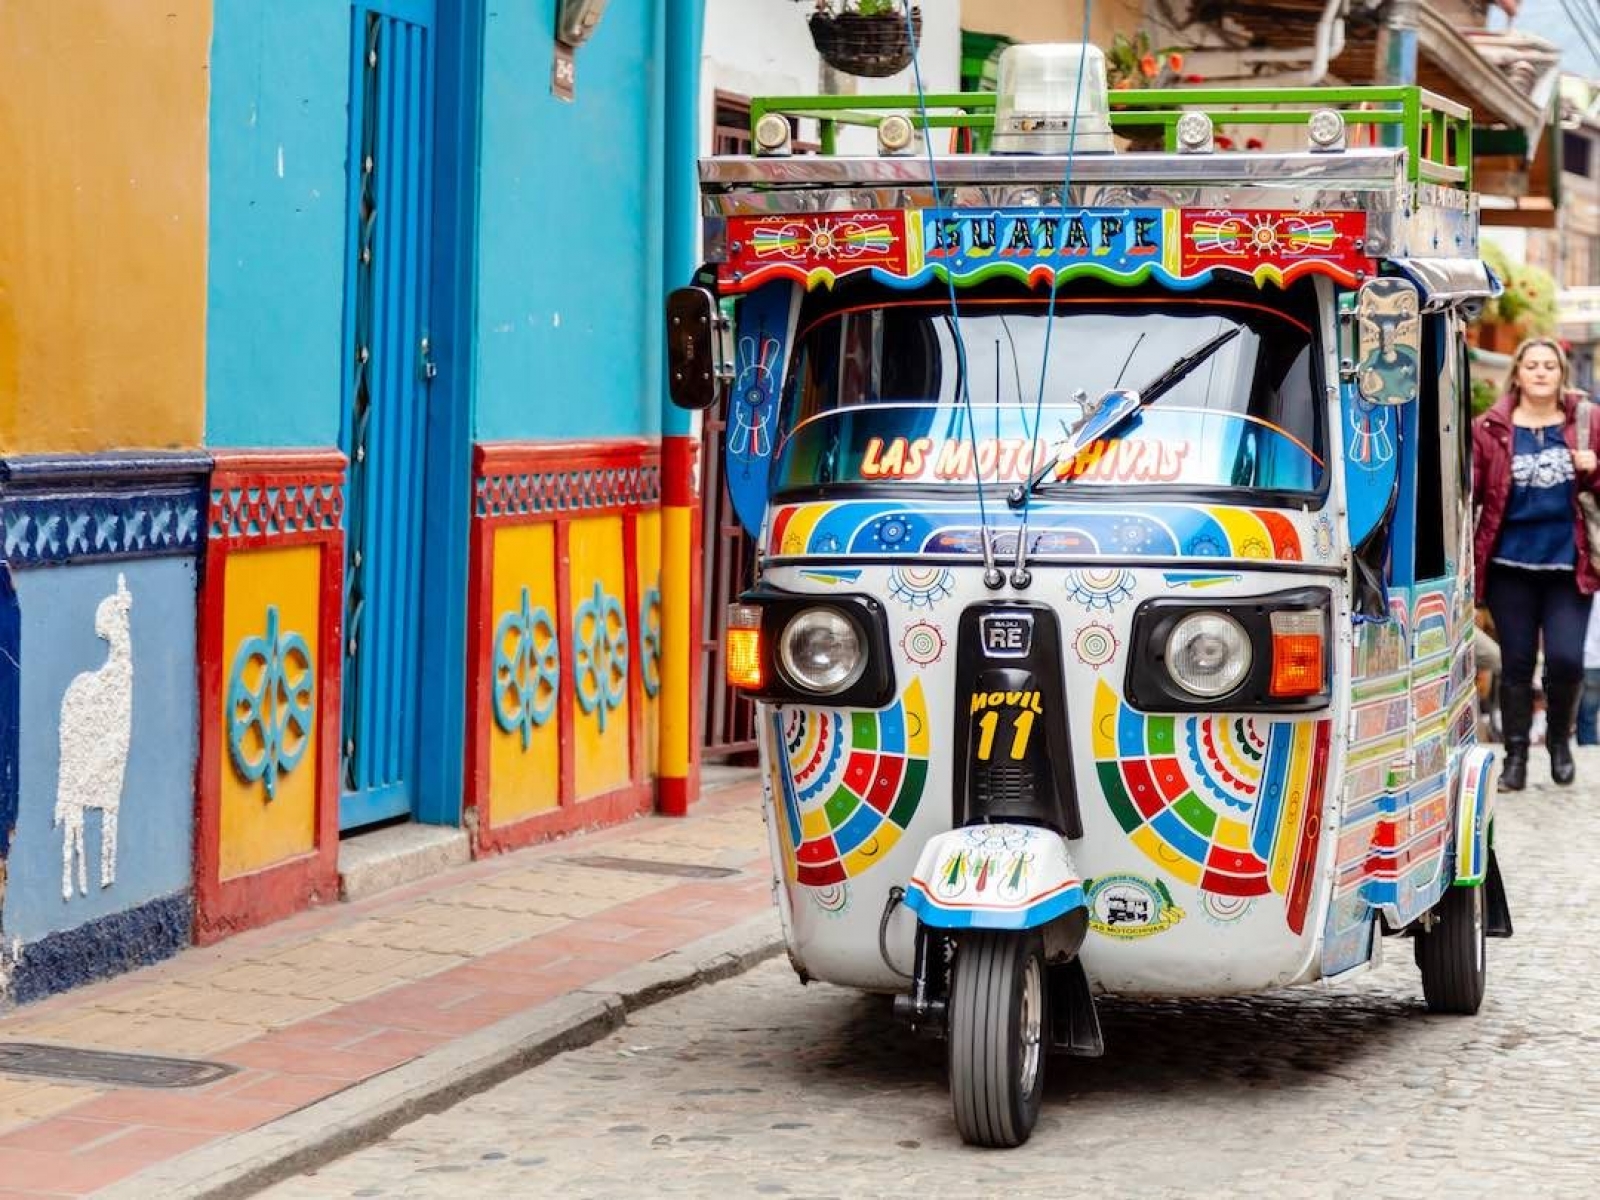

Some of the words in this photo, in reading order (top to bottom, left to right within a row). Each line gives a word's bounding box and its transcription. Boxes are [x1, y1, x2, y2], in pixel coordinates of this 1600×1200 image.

[927, 216, 1160, 256] GUATAPE
[860, 435, 934, 480] LAS
[989, 627, 1023, 648] RE
[970, 690, 1044, 715] MOVIL
[977, 710, 1035, 761] 11
